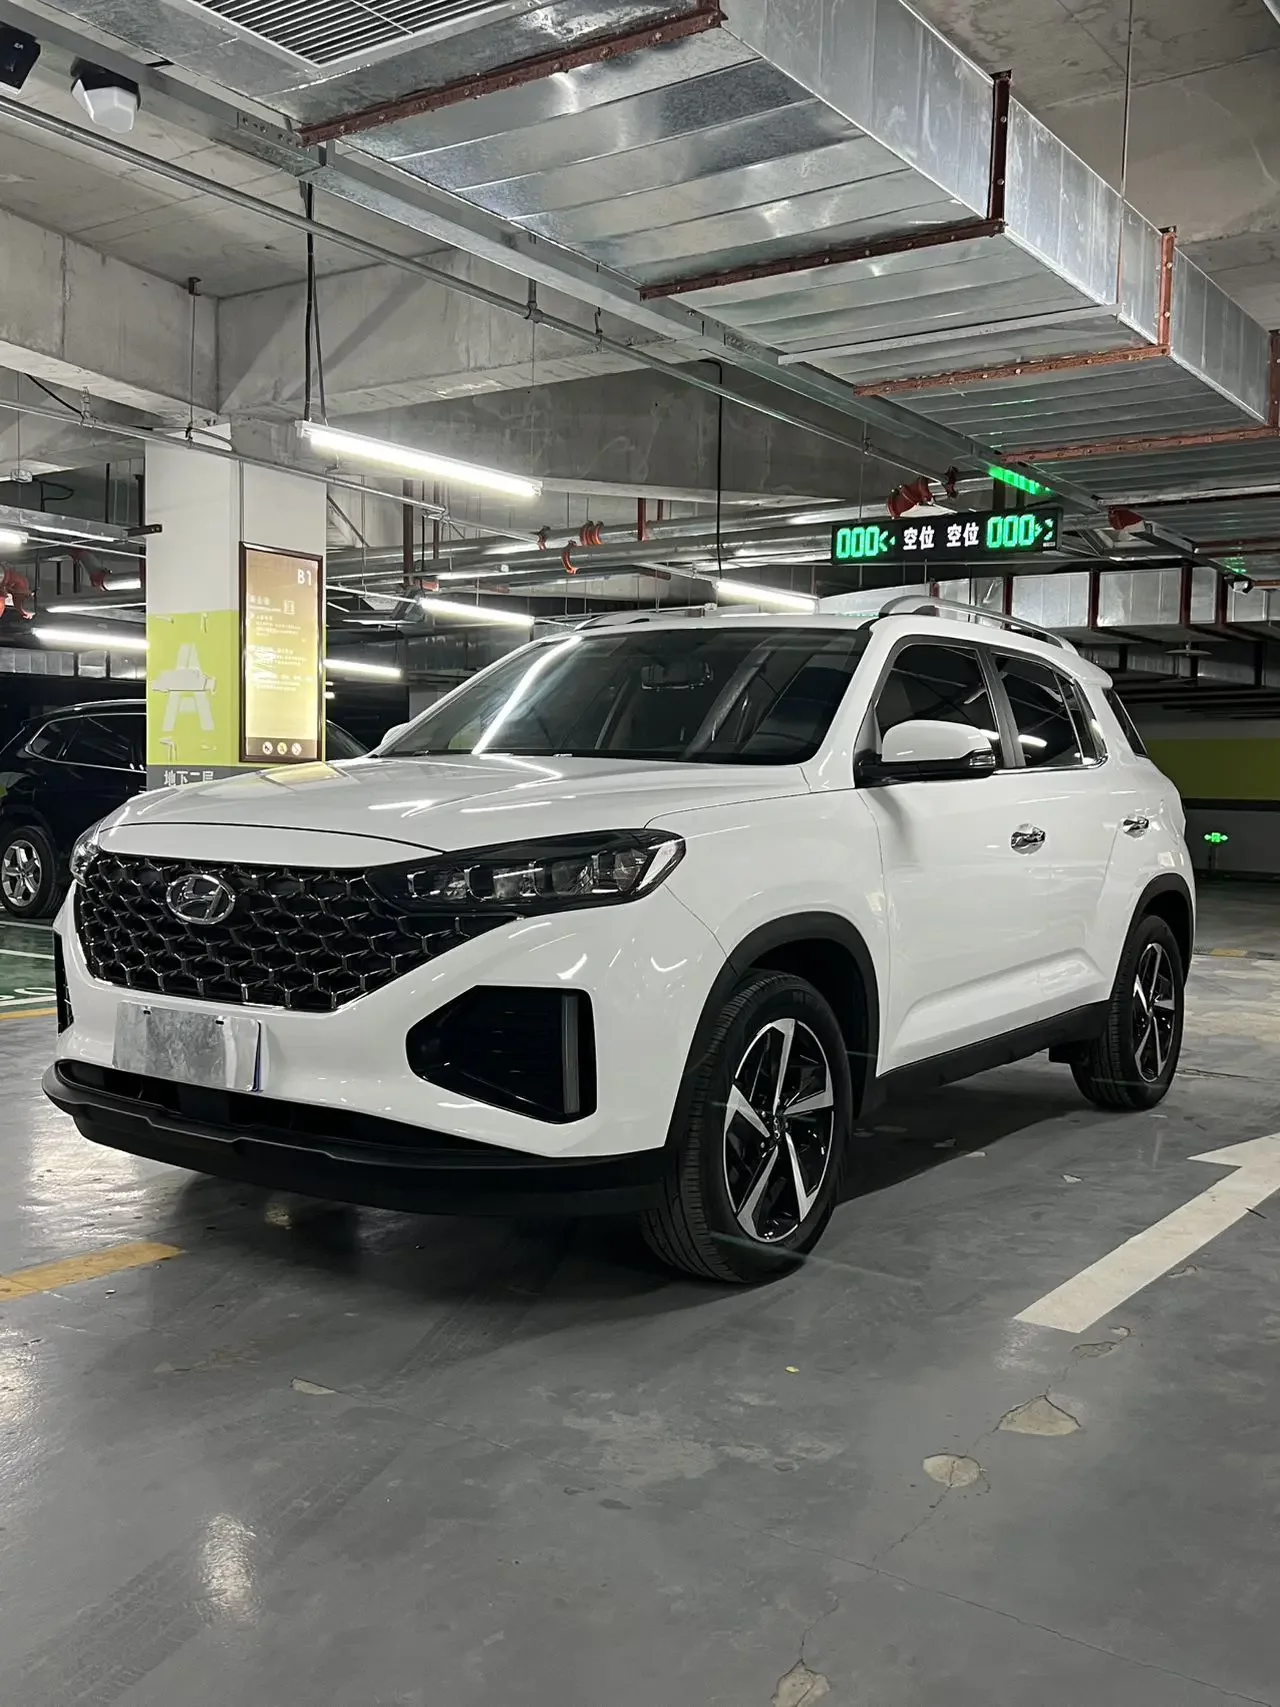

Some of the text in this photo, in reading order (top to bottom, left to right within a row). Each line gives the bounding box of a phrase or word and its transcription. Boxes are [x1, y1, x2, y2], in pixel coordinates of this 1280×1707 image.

[836, 514, 1036, 558] 000 空位 空位 000
[297, 569, 313, 586] B1
